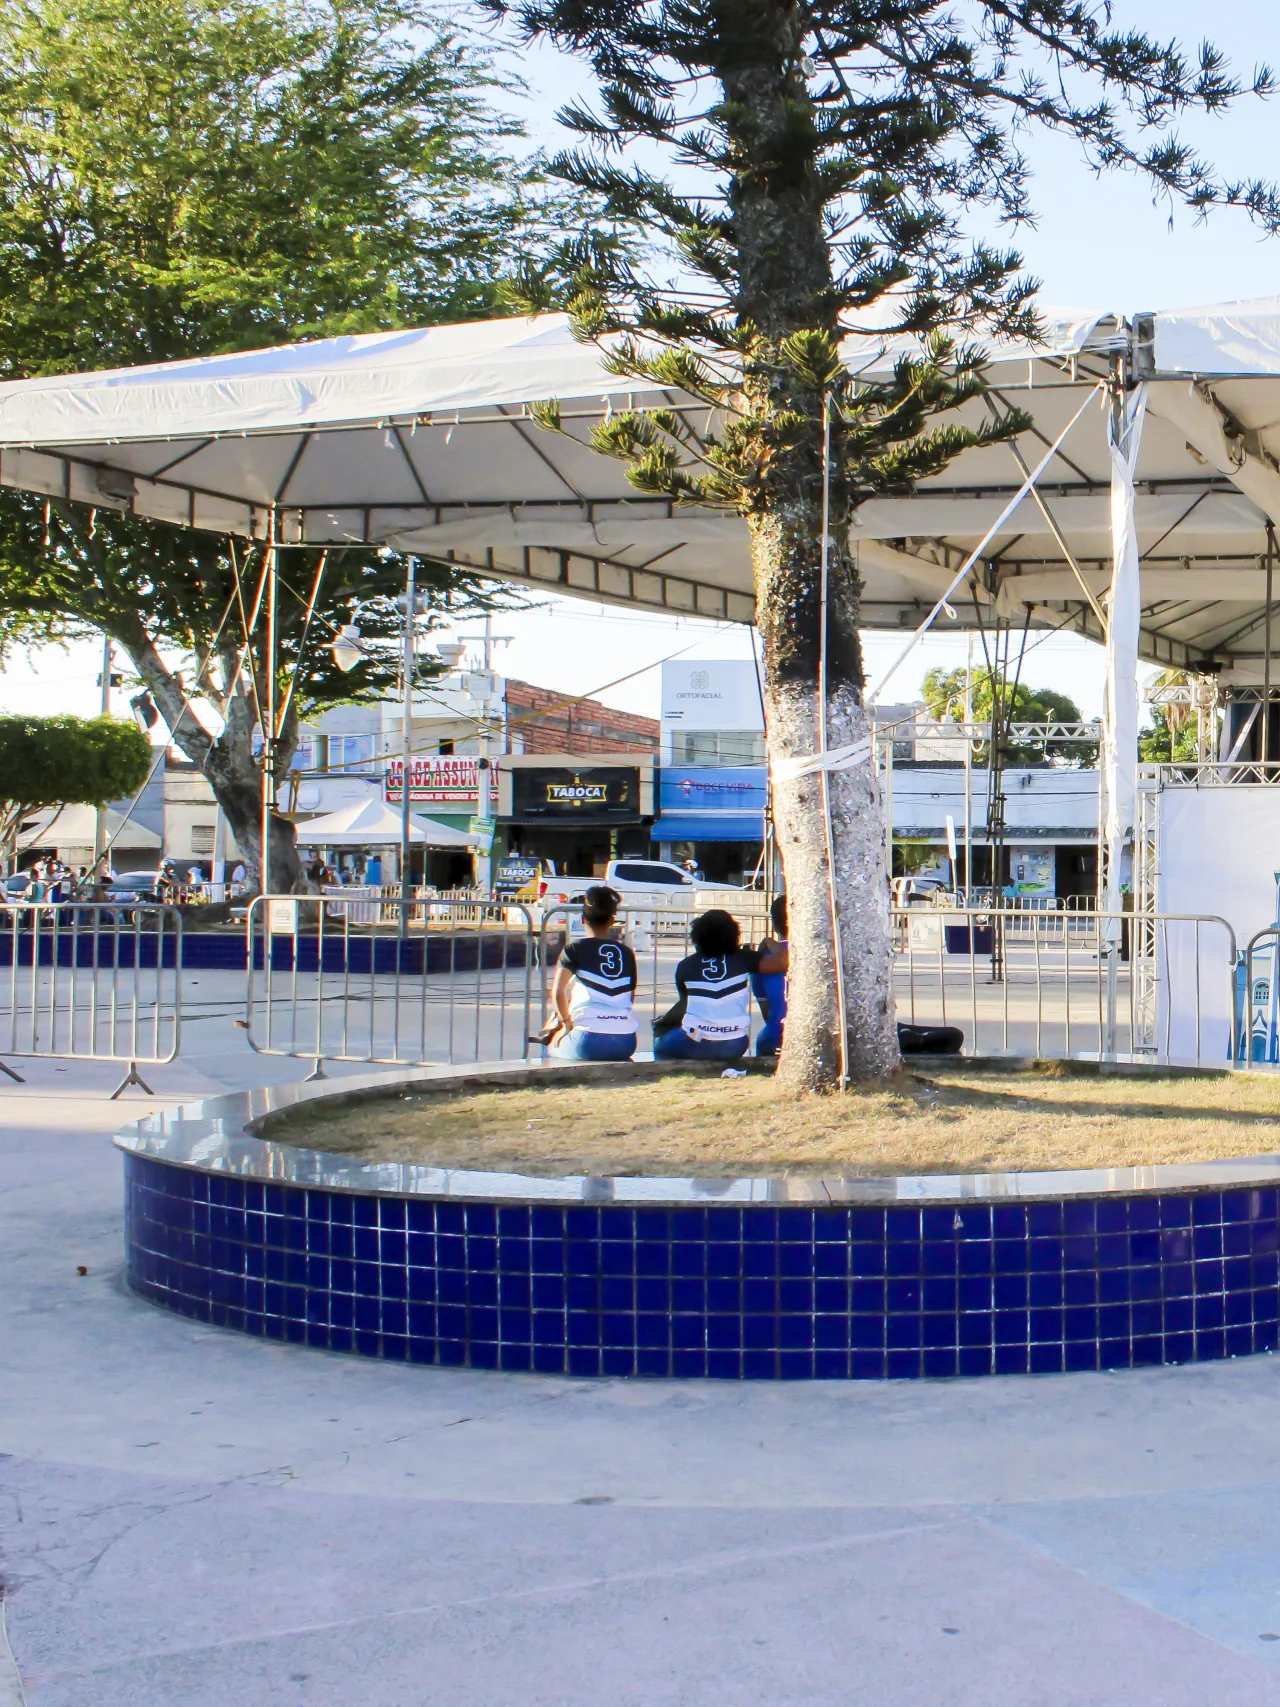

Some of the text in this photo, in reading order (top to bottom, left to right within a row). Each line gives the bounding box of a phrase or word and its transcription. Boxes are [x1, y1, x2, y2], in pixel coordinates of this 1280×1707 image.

[553, 787, 601, 797] TABOCA
[599, 944, 624, 978] 3
[702, 954, 727, 981] 3
